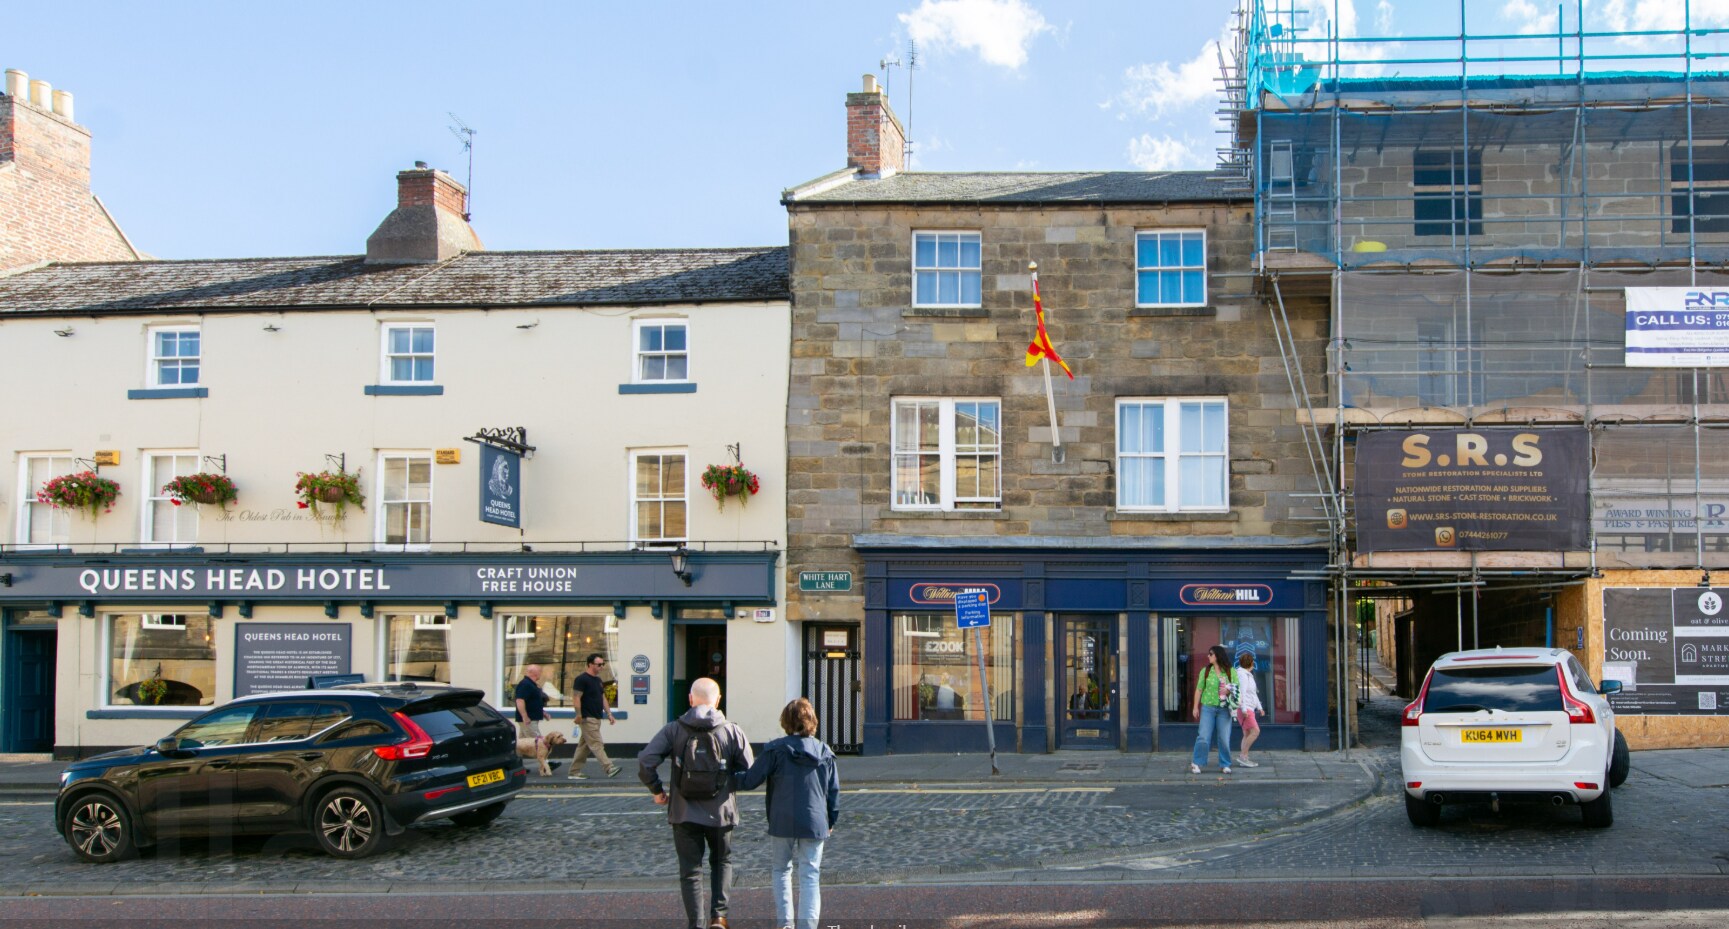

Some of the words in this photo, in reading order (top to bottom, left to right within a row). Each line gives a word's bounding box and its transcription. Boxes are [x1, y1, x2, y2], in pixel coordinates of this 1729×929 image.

[1636, 315, 1680, 325] CALL
[1684, 315, 1711, 325] US:
[1401, 433, 1543, 468] S.R.S
[490, 500, 511, 509] QUEENS
[216, 511, 234, 521] The
[239, 510, 267, 521] Oldest
[270, 508, 292, 521] Pub
[485, 506, 499, 514] HEAD
[500, 509, 516, 518] HOTEL
[477, 568, 523, 579] CRAFT
[529, 568, 576, 579] UNION
[80, 569, 196, 594] QUEENS
[207, 569, 286, 590] HEAD
[298, 569, 390, 590] HOTEL
[482, 581, 517, 592] FREE
[523, 581, 572, 592] HOUSE
[923, 586, 956, 600] Willia
[1193, 587, 1236, 601] William
[1236, 589, 1260, 600] HILL
[244, 633, 281, 642] QUEENS
[1610, 627, 1668, 643] Coming
[925, 641, 964, 652] £200K
[1610, 647, 1651, 660] Soon.
[1466, 730, 1493, 740] KU64
[1496, 730, 1517, 740] MVH
[472, 775, 489, 785] CF21
